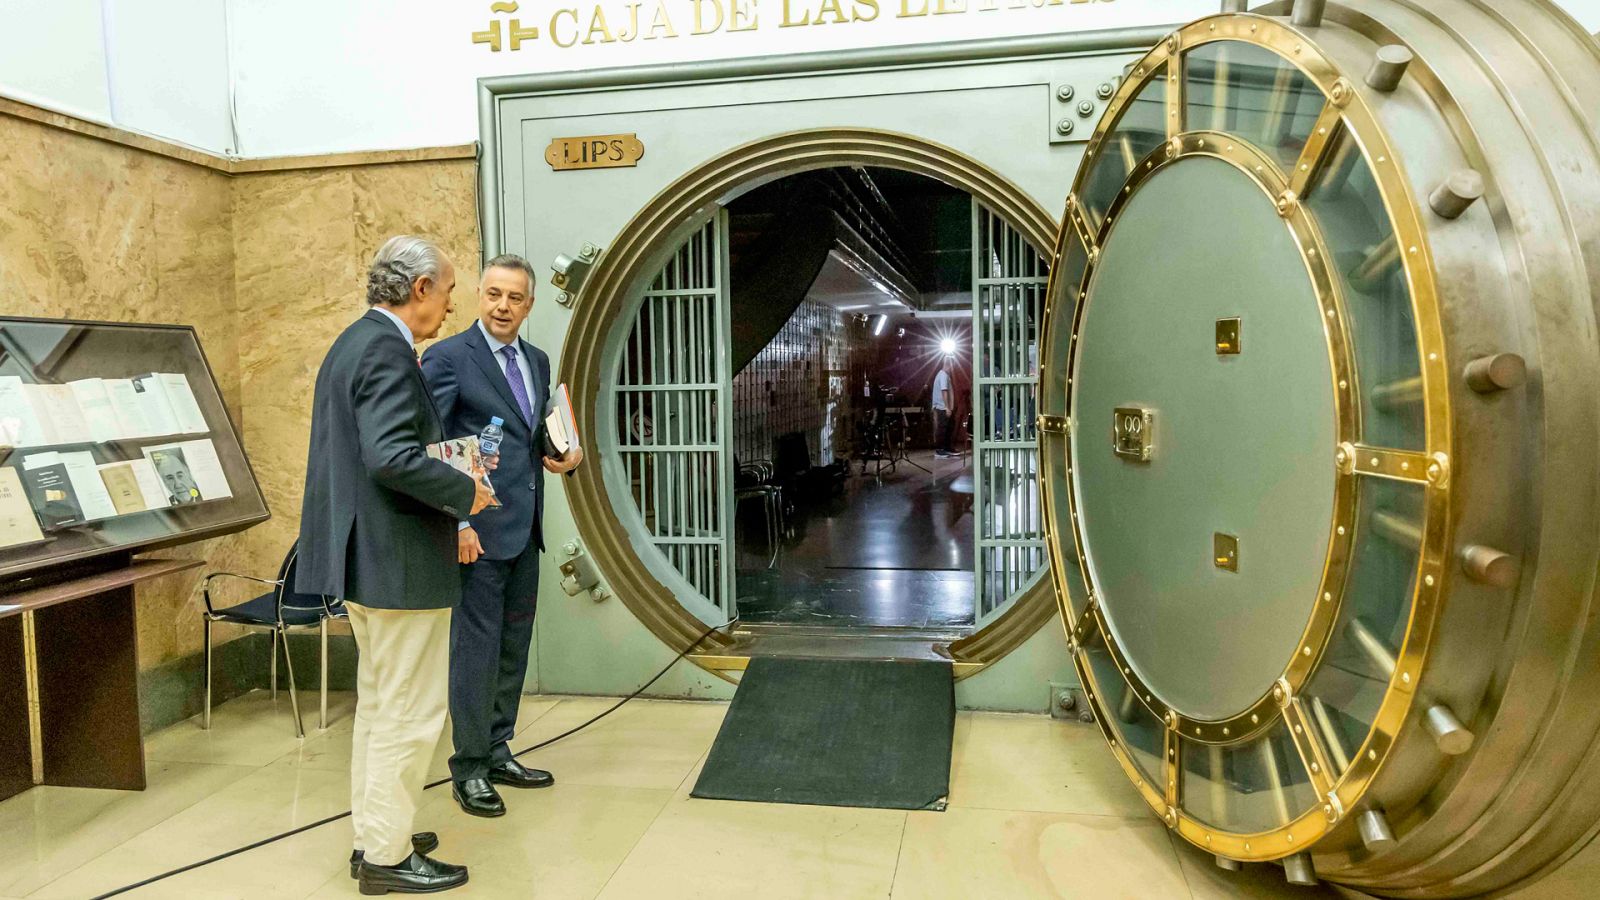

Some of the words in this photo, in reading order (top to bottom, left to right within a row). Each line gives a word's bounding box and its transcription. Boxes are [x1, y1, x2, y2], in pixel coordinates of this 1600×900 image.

[549, 0, 679, 48] CAJA
[690, 0, 758, 35] DE
[563, 140, 624, 164] LIPS
